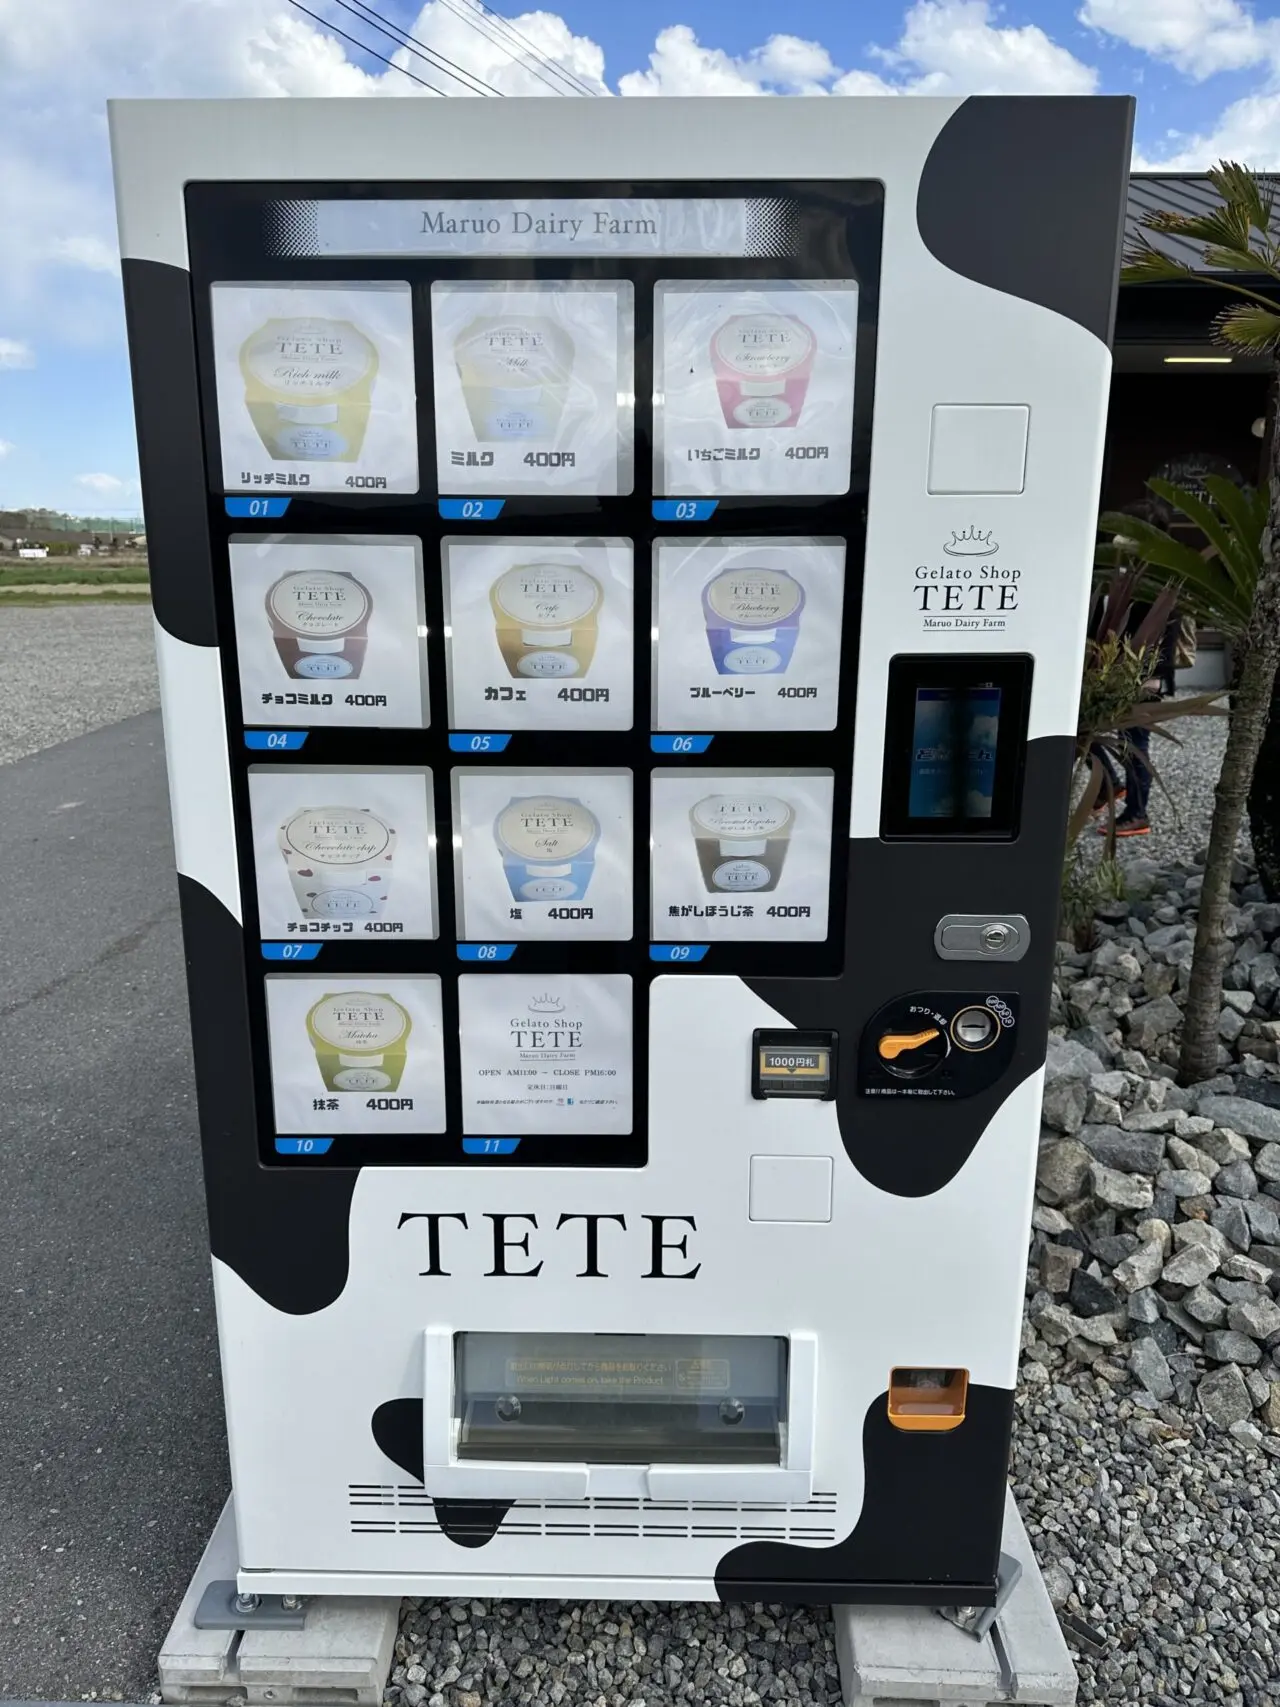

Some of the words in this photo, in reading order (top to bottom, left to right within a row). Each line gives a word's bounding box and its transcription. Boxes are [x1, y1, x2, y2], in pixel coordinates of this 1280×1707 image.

[421, 211, 500, 234] Maruo
[512, 211, 583, 241] Dairy
[593, 211, 657, 234] Farm
[739, 333, 791, 343] TETE
[276, 342, 343, 355] TETE
[313, 369, 344, 380] milk
[451, 451, 494, 466] ミルク
[523, 452, 576, 467] 400円
[688, 448, 760, 461] いちごミルク
[785, 446, 829, 459] 400円
[241, 472, 310, 486] リッチミルク
[345, 476, 387, 489] 400円
[249, 500, 268, 516] 01
[462, 501, 482, 517] 02
[675, 502, 697, 518] 03
[915, 565, 972, 579] Gelato
[979, 565, 1021, 582] Shop
[520, 584, 576, 592] TETE
[730, 586, 781, 595] TETE
[292, 591, 346, 601] TETE
[913, 585, 1019, 611] TETE
[733, 602, 780, 613] Blueberry
[296, 610, 344, 622] Chocolate
[923, 619, 951, 627] Maruo
[955, 618, 980, 628] Dairy
[983, 618, 1006, 627] Farm
[484, 686, 527, 701] カフェ
[557, 688, 610, 702] 400円
[689, 687, 756, 698] ブルーベリー
[777, 687, 818, 698] 400円
[261, 693, 333, 705] チョコミルク
[345, 694, 387, 706] 400円
[267, 733, 288, 748] 04
[470, 735, 491, 751] 05
[672, 737, 693, 752] 06
[520, 818, 574, 828] TETE
[308, 825, 368, 835] TETE
[305, 843, 355, 852] Chocolate
[535, 839, 559, 848] Salt
[509, 908, 523, 920] 塩
[548, 907, 594, 920] 400円
[668, 905, 754, 917] 焦がしほうじ茶
[767, 906, 811, 917] 400円
[287, 922, 353, 933] チョコチップ
[364, 922, 404, 933] 400円
[282, 945, 302, 958] 07
[477, 945, 497, 959] 08
[670, 946, 690, 960] 09
[332, 1012, 385, 1021] TETE
[510, 1018, 550, 1029] Gelato
[554, 1018, 583, 1030] Shop
[342, 1030, 378, 1039] Matcha
[510, 1030, 583, 1048] TETE
[769, 1056, 815, 1068] 1000円札
[313, 1098, 340, 1111] 抹茶
[366, 1098, 414, 1111] 400円
[296, 1140, 314, 1152] 10
[484, 1139, 500, 1153] 11
[397, 1212, 702, 1280] TETE
[633, 1374, 664, 1385] Product
